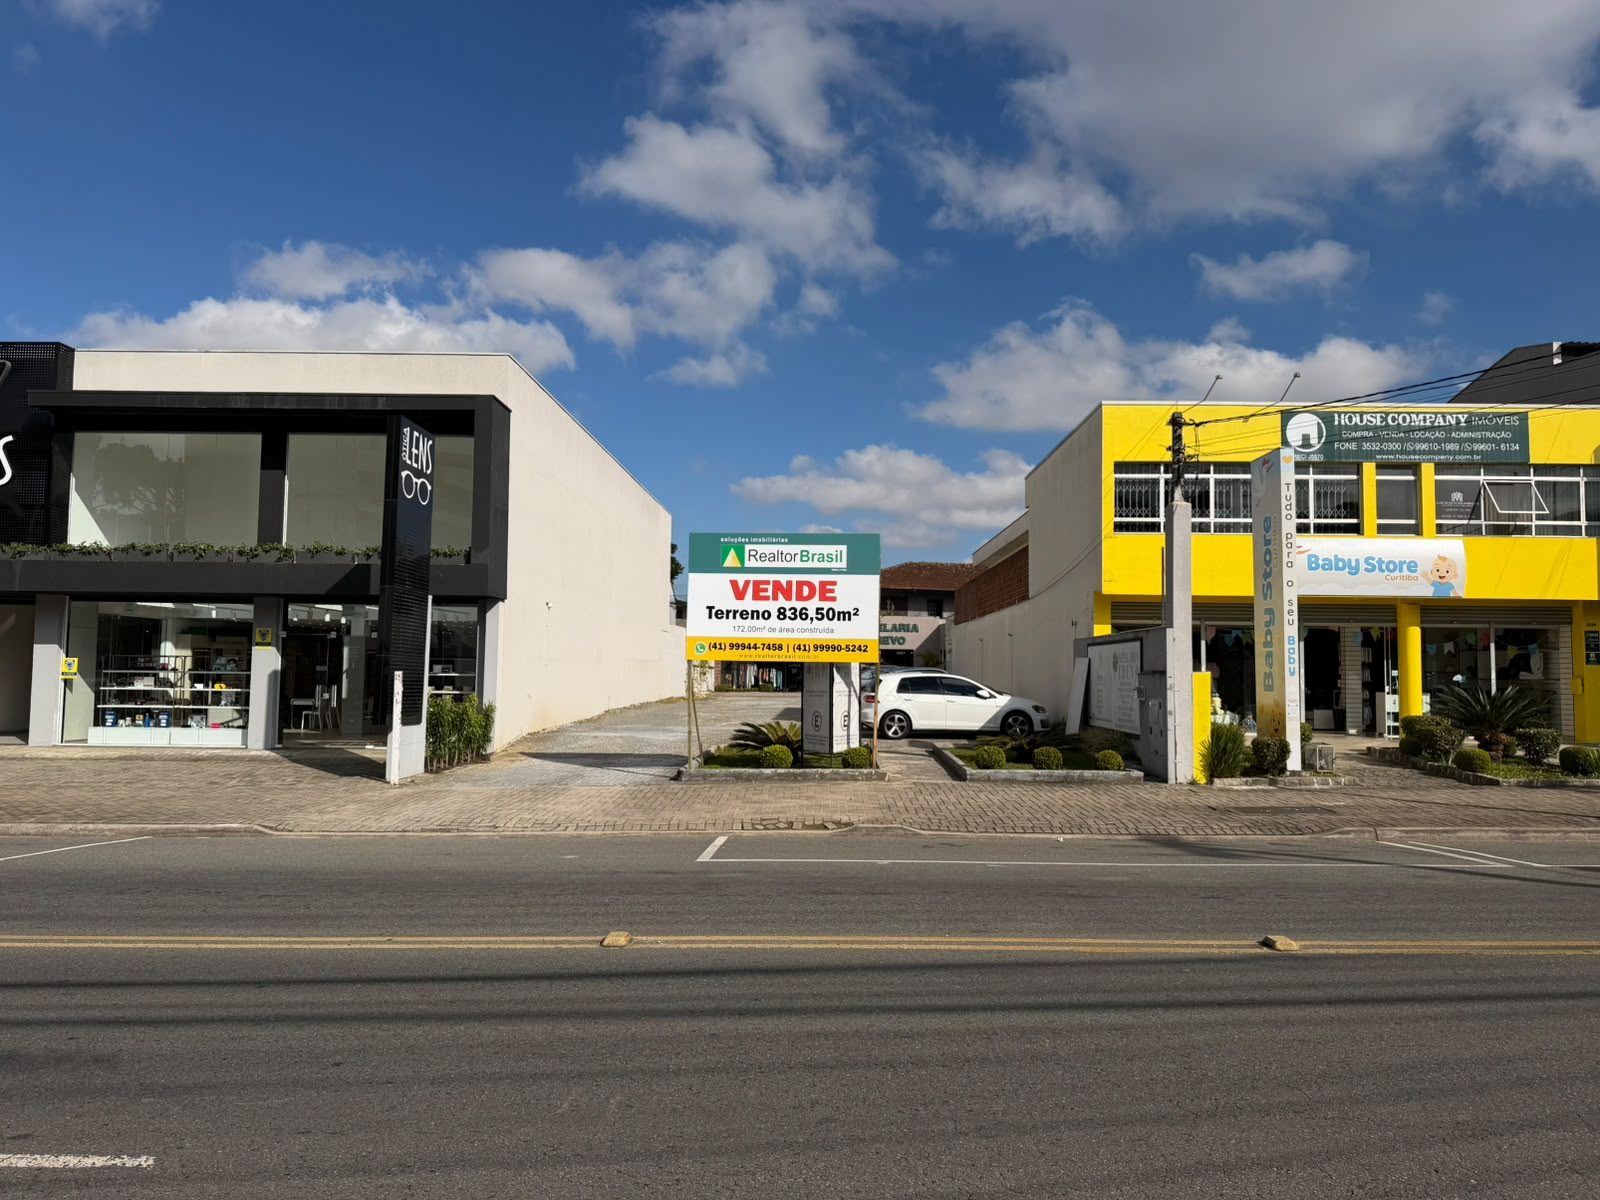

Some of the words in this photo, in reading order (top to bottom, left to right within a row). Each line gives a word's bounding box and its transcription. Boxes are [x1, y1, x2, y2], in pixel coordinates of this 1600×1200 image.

[1333, 413, 1386, 426] HOUSE
[1387, 413, 1469, 426] COMPANY
[1471, 414, 1520, 426] IMÓVEIS
[1341, 430, 1374, 438] COMPRA
[1410, 430, 1446, 439] LOCAÇÃO
[1451, 430, 1512, 439] ADMINISTRAÇÃO
[406, 426, 433, 475] LENS
[1334, 442, 1358, 450] FONE
[1361, 442, 1402, 450] 3532-0300
[1501, 443, 1520, 451] 6134
[1375, 453, 1482, 461] www.housecompany.com.br
[1284, 482, 1293, 521] Tudo
[1262, 515, 1273, 601] Store
[1285, 532, 1294, 568] para
[1306, 553, 1361, 576] Baby
[1363, 555, 1419, 574] Store
[1286, 579, 1294, 588] o
[1384, 574, 1419, 582] Curitiba
[729, 579, 838, 602] VENDE
[706, 605, 772, 621] Terreno
[776, 606, 860, 624] 836,50m²
[1287, 599, 1295, 626] seu
[767, 625, 777, 633] de
[778, 626, 795, 634] área
[796, 626, 835, 635] construída
[708, 642, 727, 652] (41)
[728, 643, 784, 652] 99944-7458
[792, 643, 811, 653] (41)
[813, 644, 869, 653] 99990-5242
[1263, 607, 1276, 692] Baby
[1287, 635, 1296, 677] Baby
